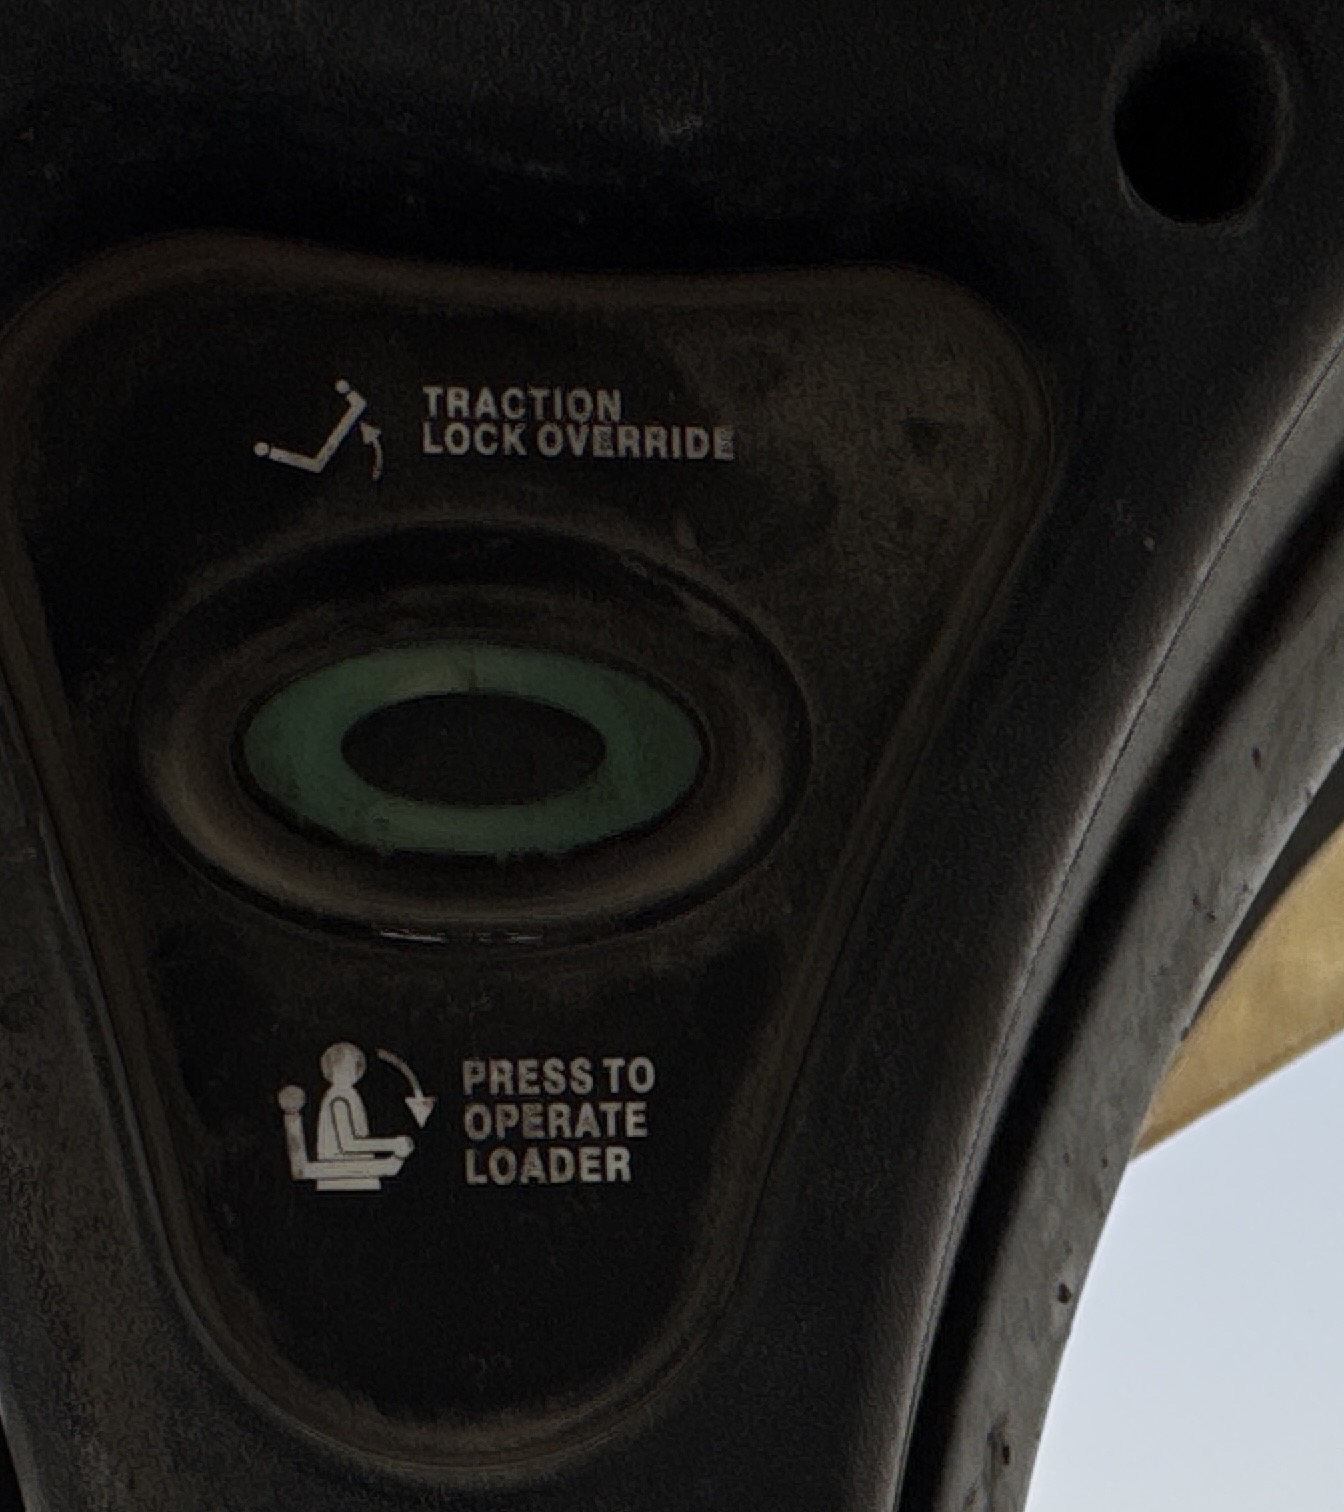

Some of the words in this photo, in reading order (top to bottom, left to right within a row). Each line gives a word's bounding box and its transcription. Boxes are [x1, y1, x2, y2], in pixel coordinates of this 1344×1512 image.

[422, 386, 622, 422] TRACTION
[422, 422, 527, 456] LOCK
[538, 423, 735, 461] OVERRIDE
[462, 1057, 595, 1095] PRESS
[602, 1056, 656, 1094] TO
[464, 1102, 648, 1140] OPERATE
[464, 1146, 633, 1184] LOADER
